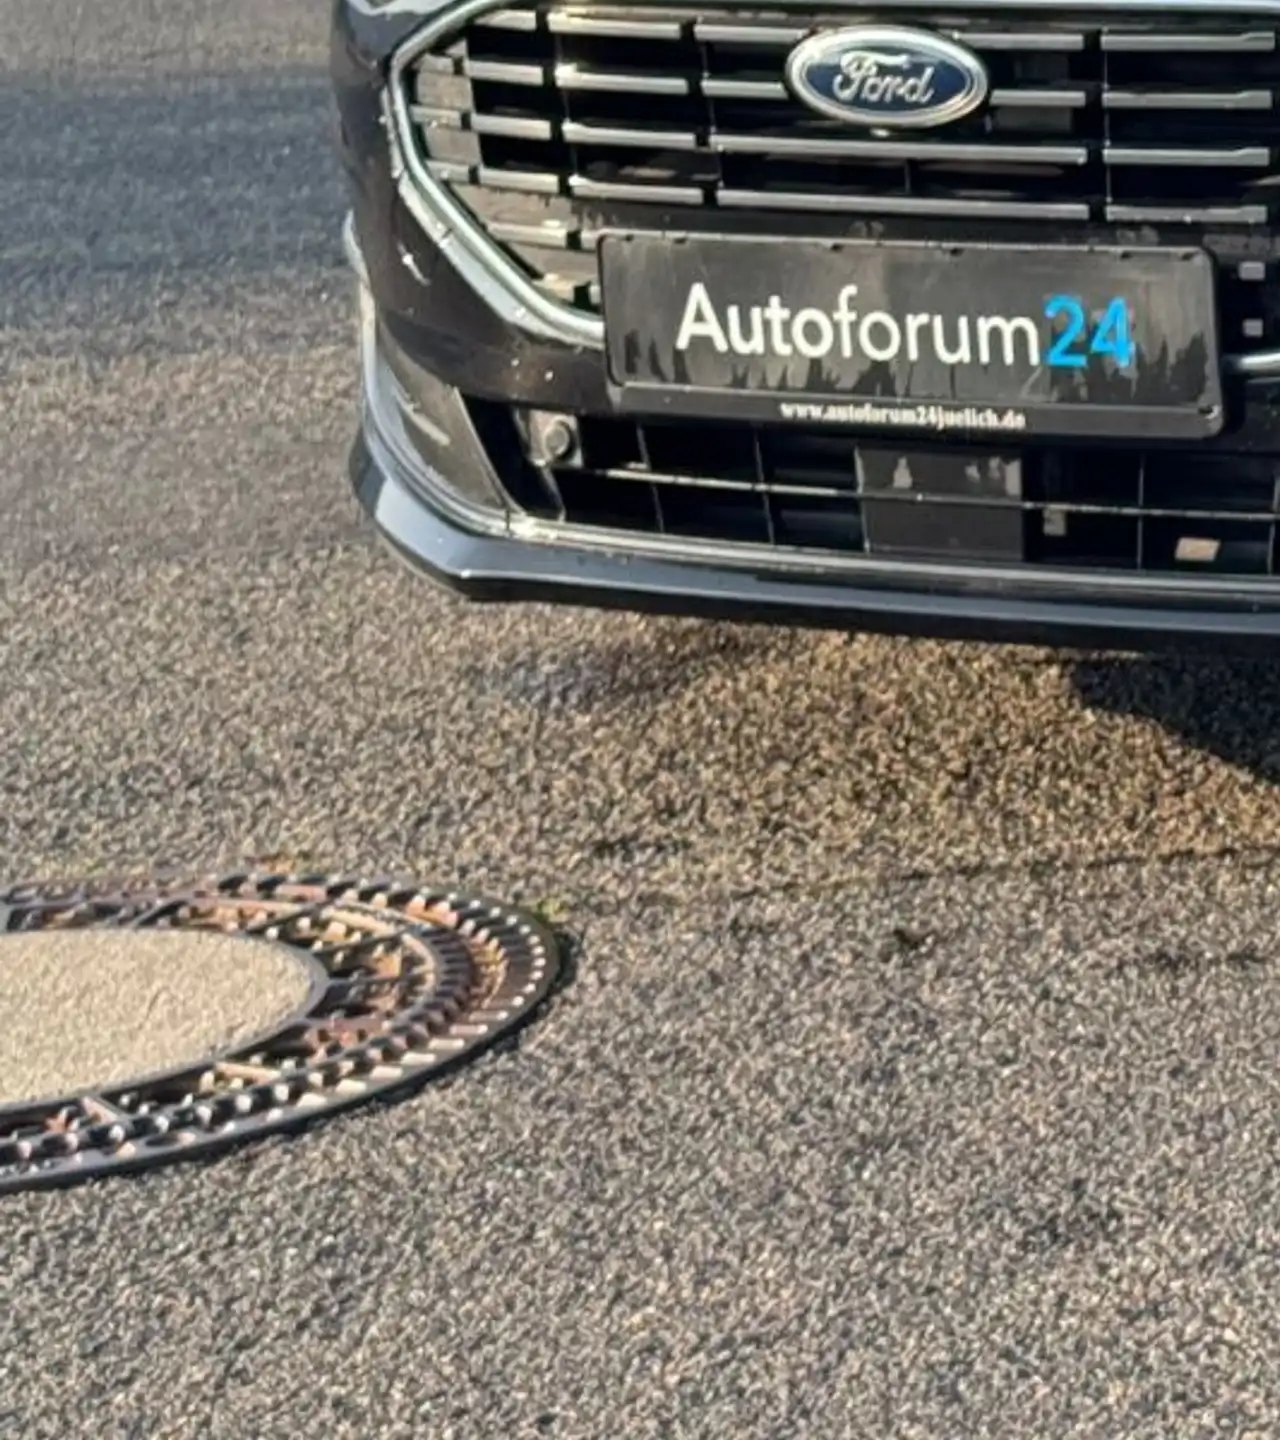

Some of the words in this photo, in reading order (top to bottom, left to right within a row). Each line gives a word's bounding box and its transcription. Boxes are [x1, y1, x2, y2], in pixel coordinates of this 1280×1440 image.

[832, 50, 936, 104] Ford
[674, 281, 1136, 368] Autoforum24
[779, 402, 1027, 430] www.autoforum24juelich.de
